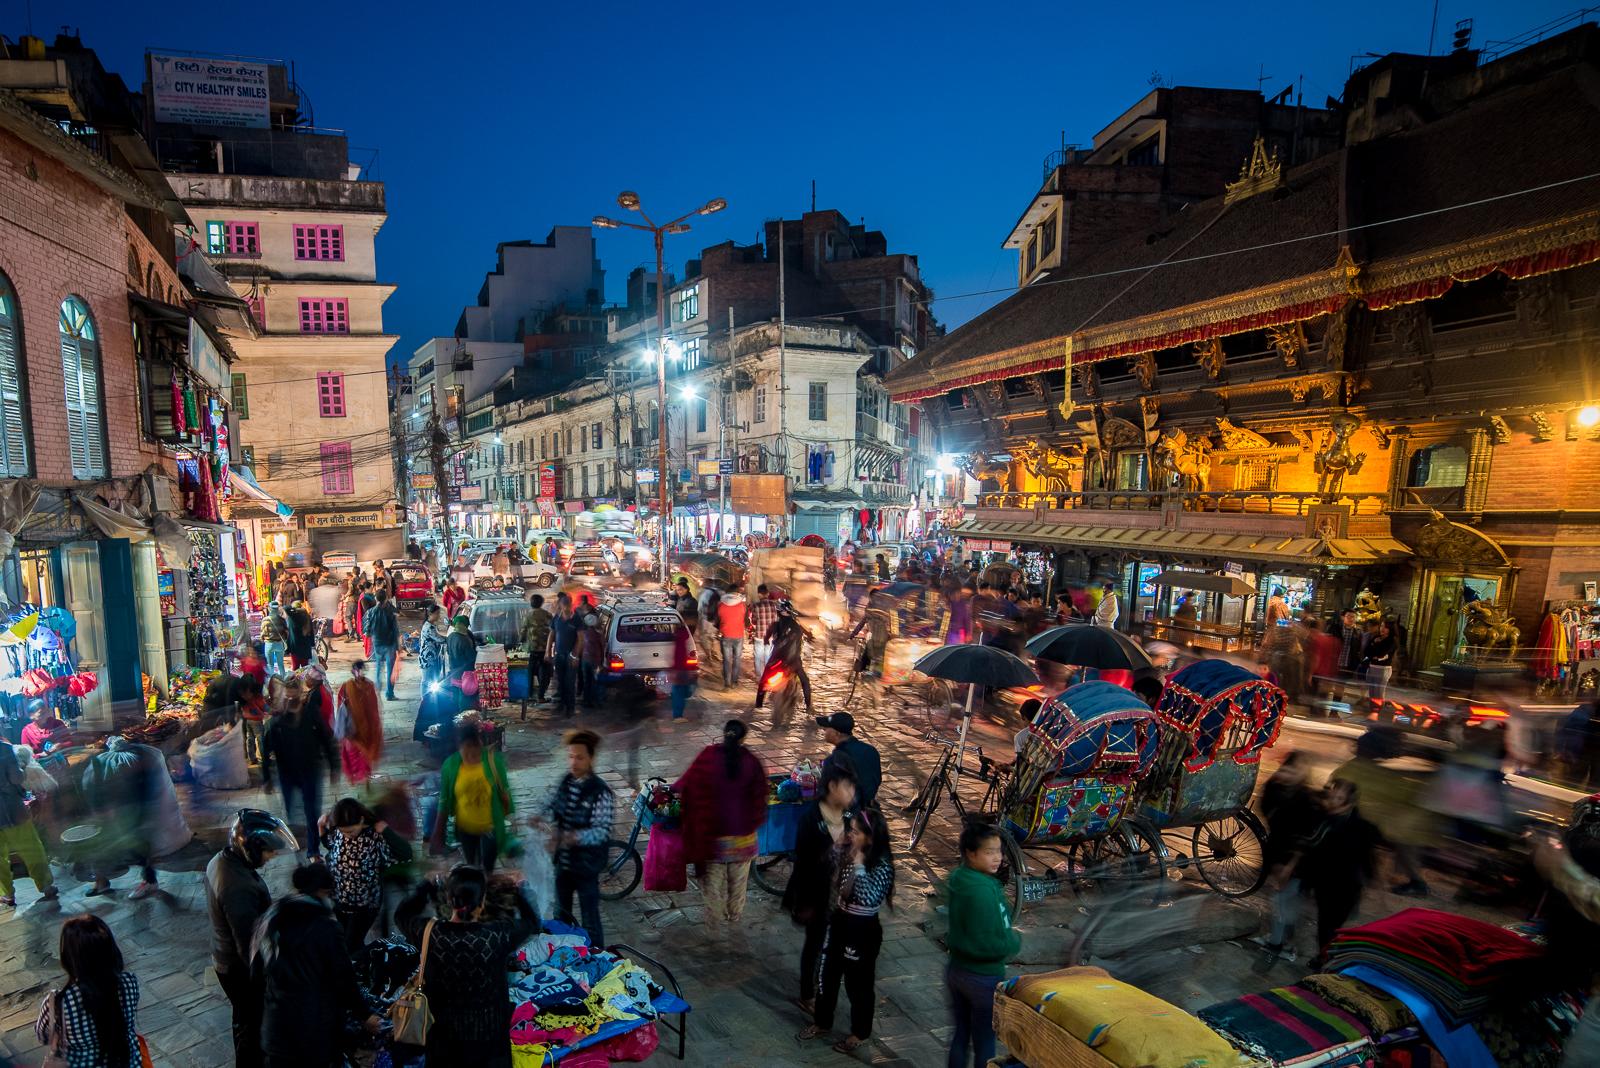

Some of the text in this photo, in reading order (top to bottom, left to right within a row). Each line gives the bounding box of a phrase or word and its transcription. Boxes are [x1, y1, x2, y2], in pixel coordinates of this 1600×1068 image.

[175, 82, 267, 98] CITY HEALTHY SMILES
